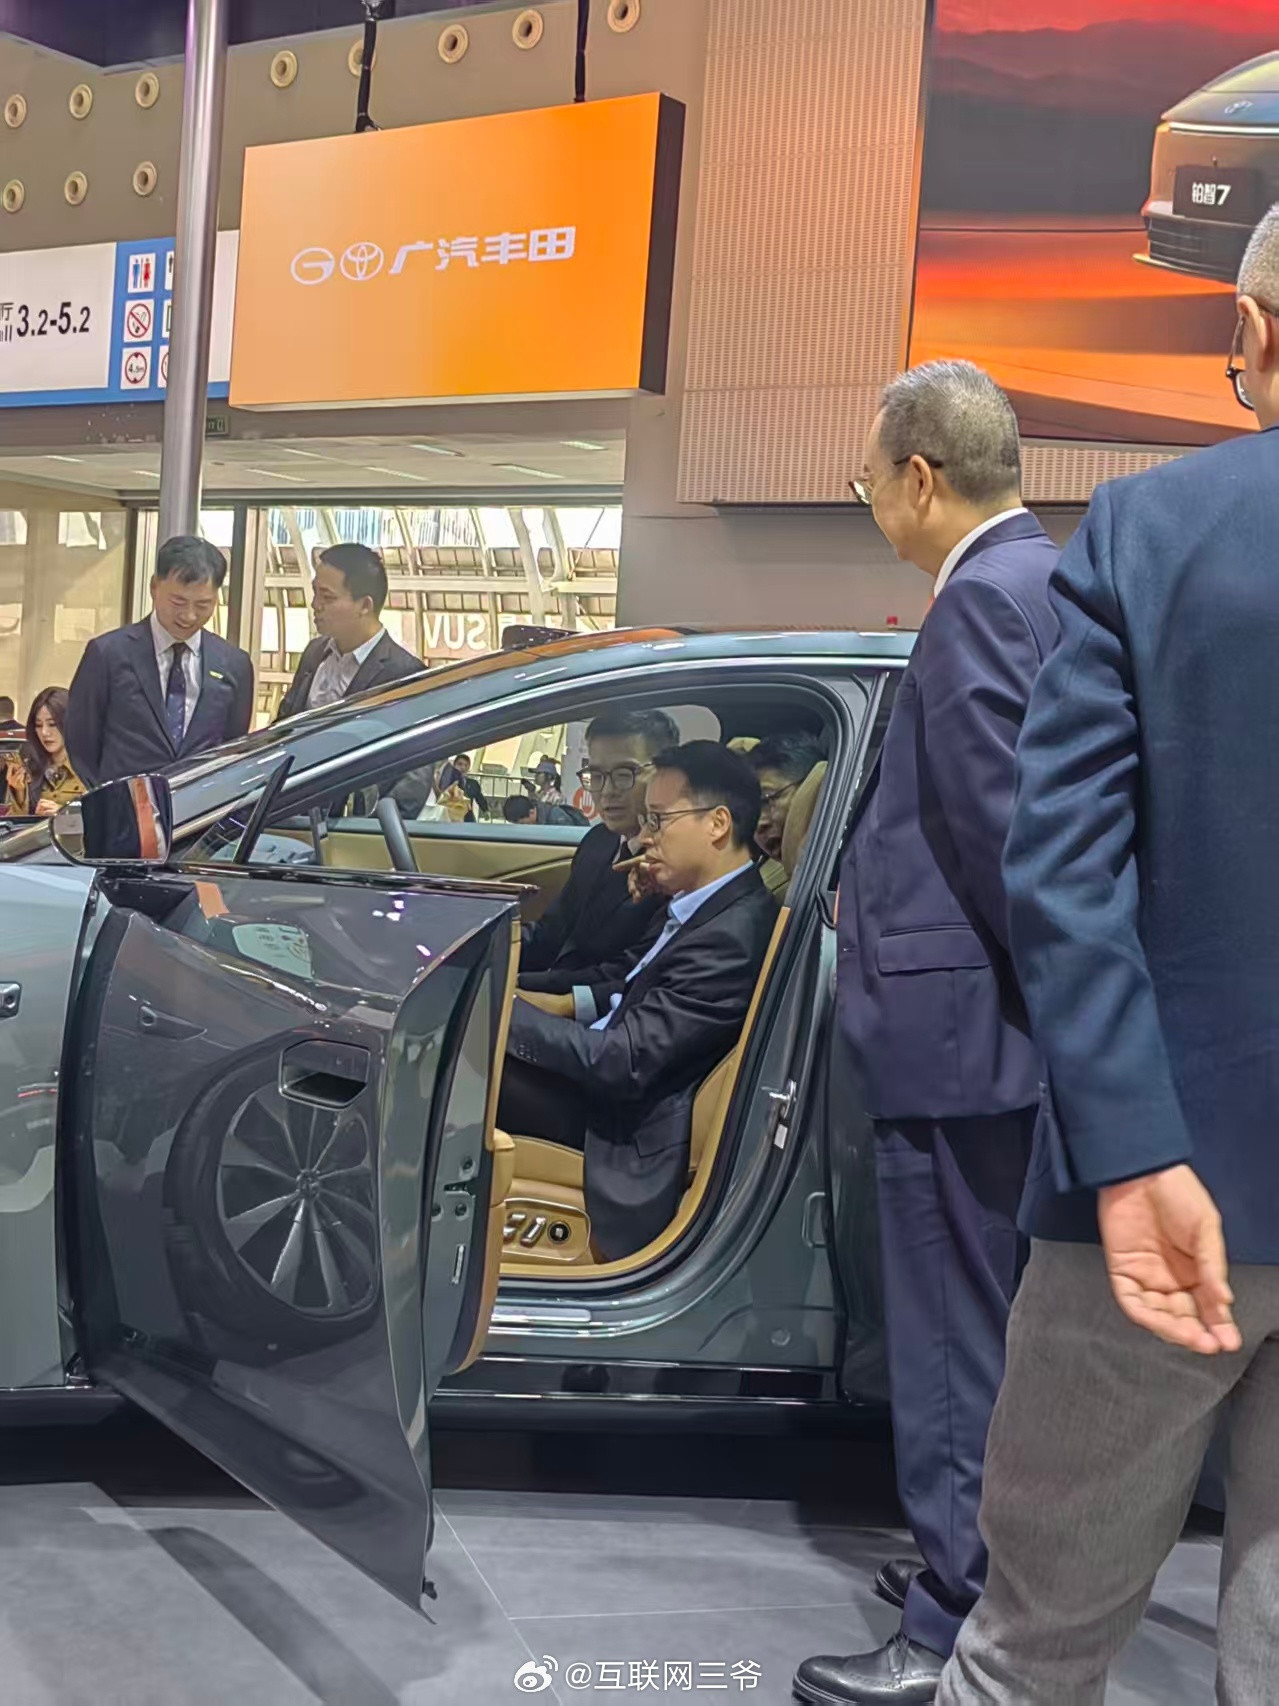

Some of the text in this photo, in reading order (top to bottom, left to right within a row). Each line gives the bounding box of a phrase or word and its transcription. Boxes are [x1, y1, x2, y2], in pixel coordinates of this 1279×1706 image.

[1191, 182, 1231, 206] 铂智7
[388, 226, 577, 275] 广汽丰田
[17, 301, 91, 337] 3.2-5.2
